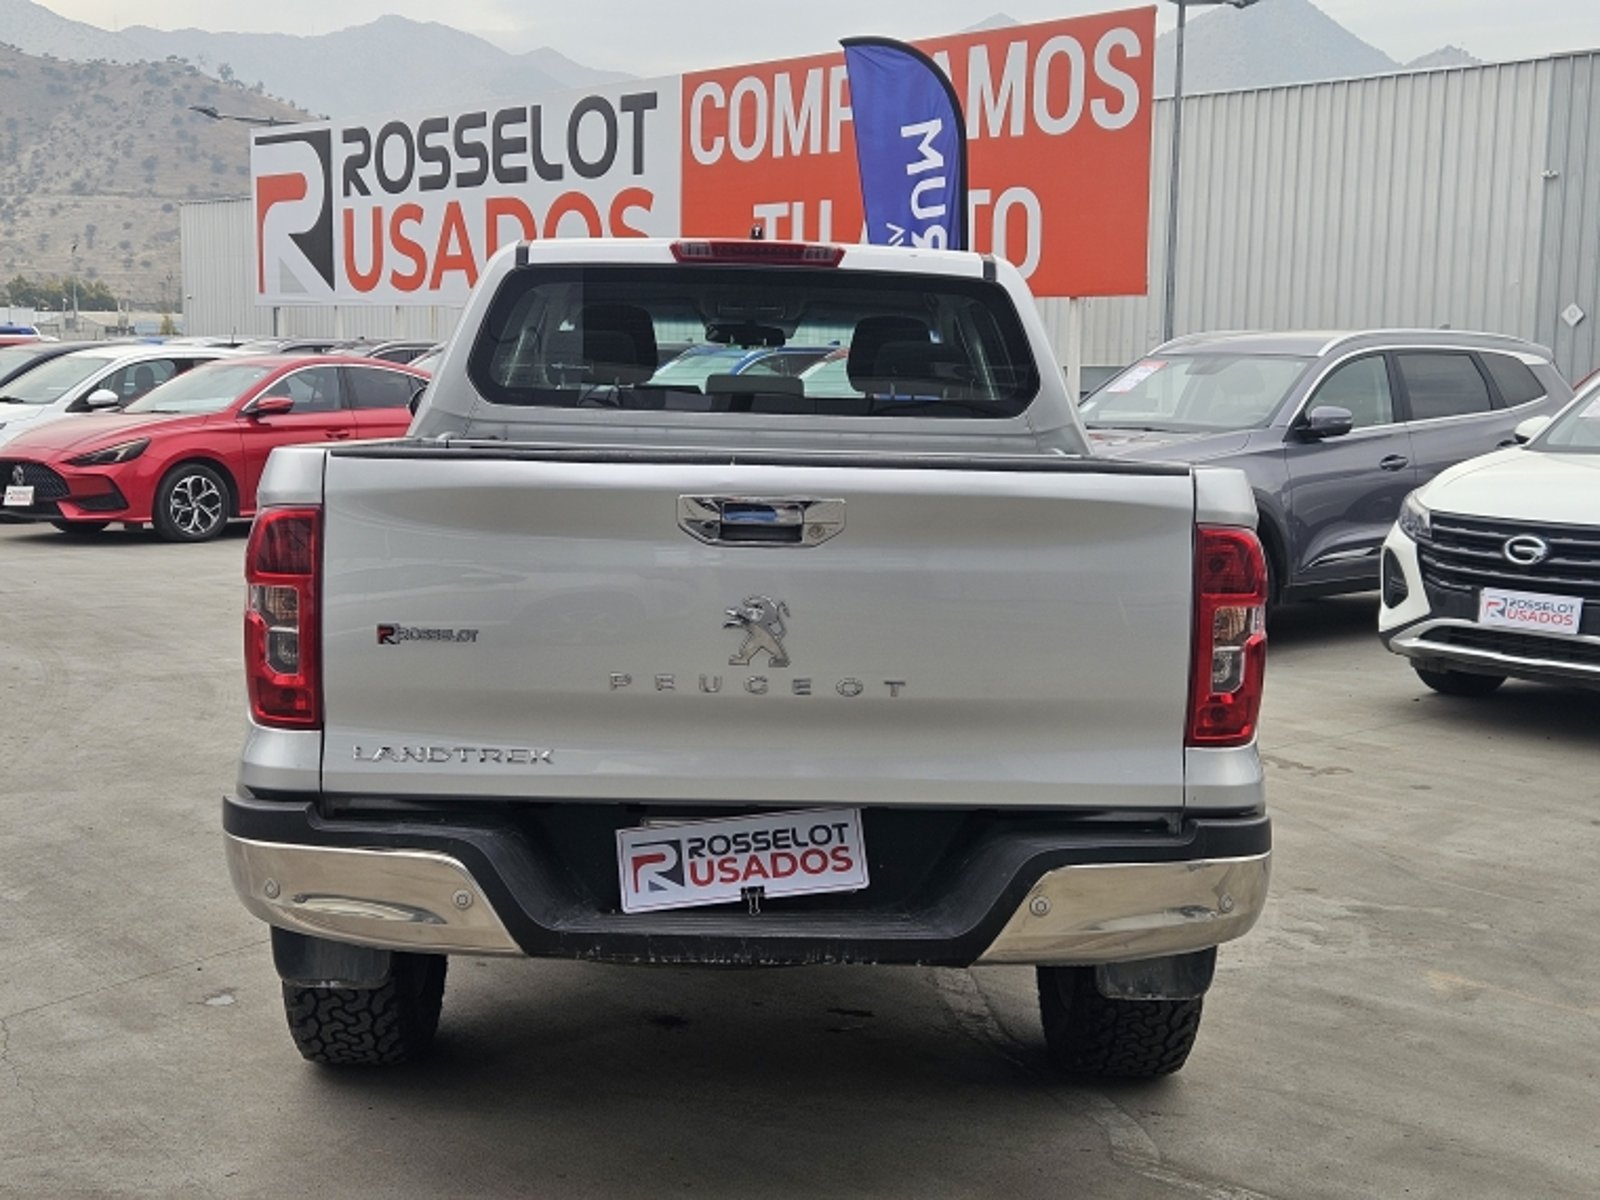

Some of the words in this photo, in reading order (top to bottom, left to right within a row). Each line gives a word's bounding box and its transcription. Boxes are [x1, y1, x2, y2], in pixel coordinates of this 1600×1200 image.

[690, 27, 1142, 165] COMPMOS
[342, 91, 658, 197] ROSSELOT
[1507, 607, 1574, 626] USADOS
[609, 671, 907, 698] PEUGEOT
[352, 745, 555, 766] LANDTREK
[688, 822, 849, 859] ROSSELOT
[689, 845, 854, 887] USADOS
